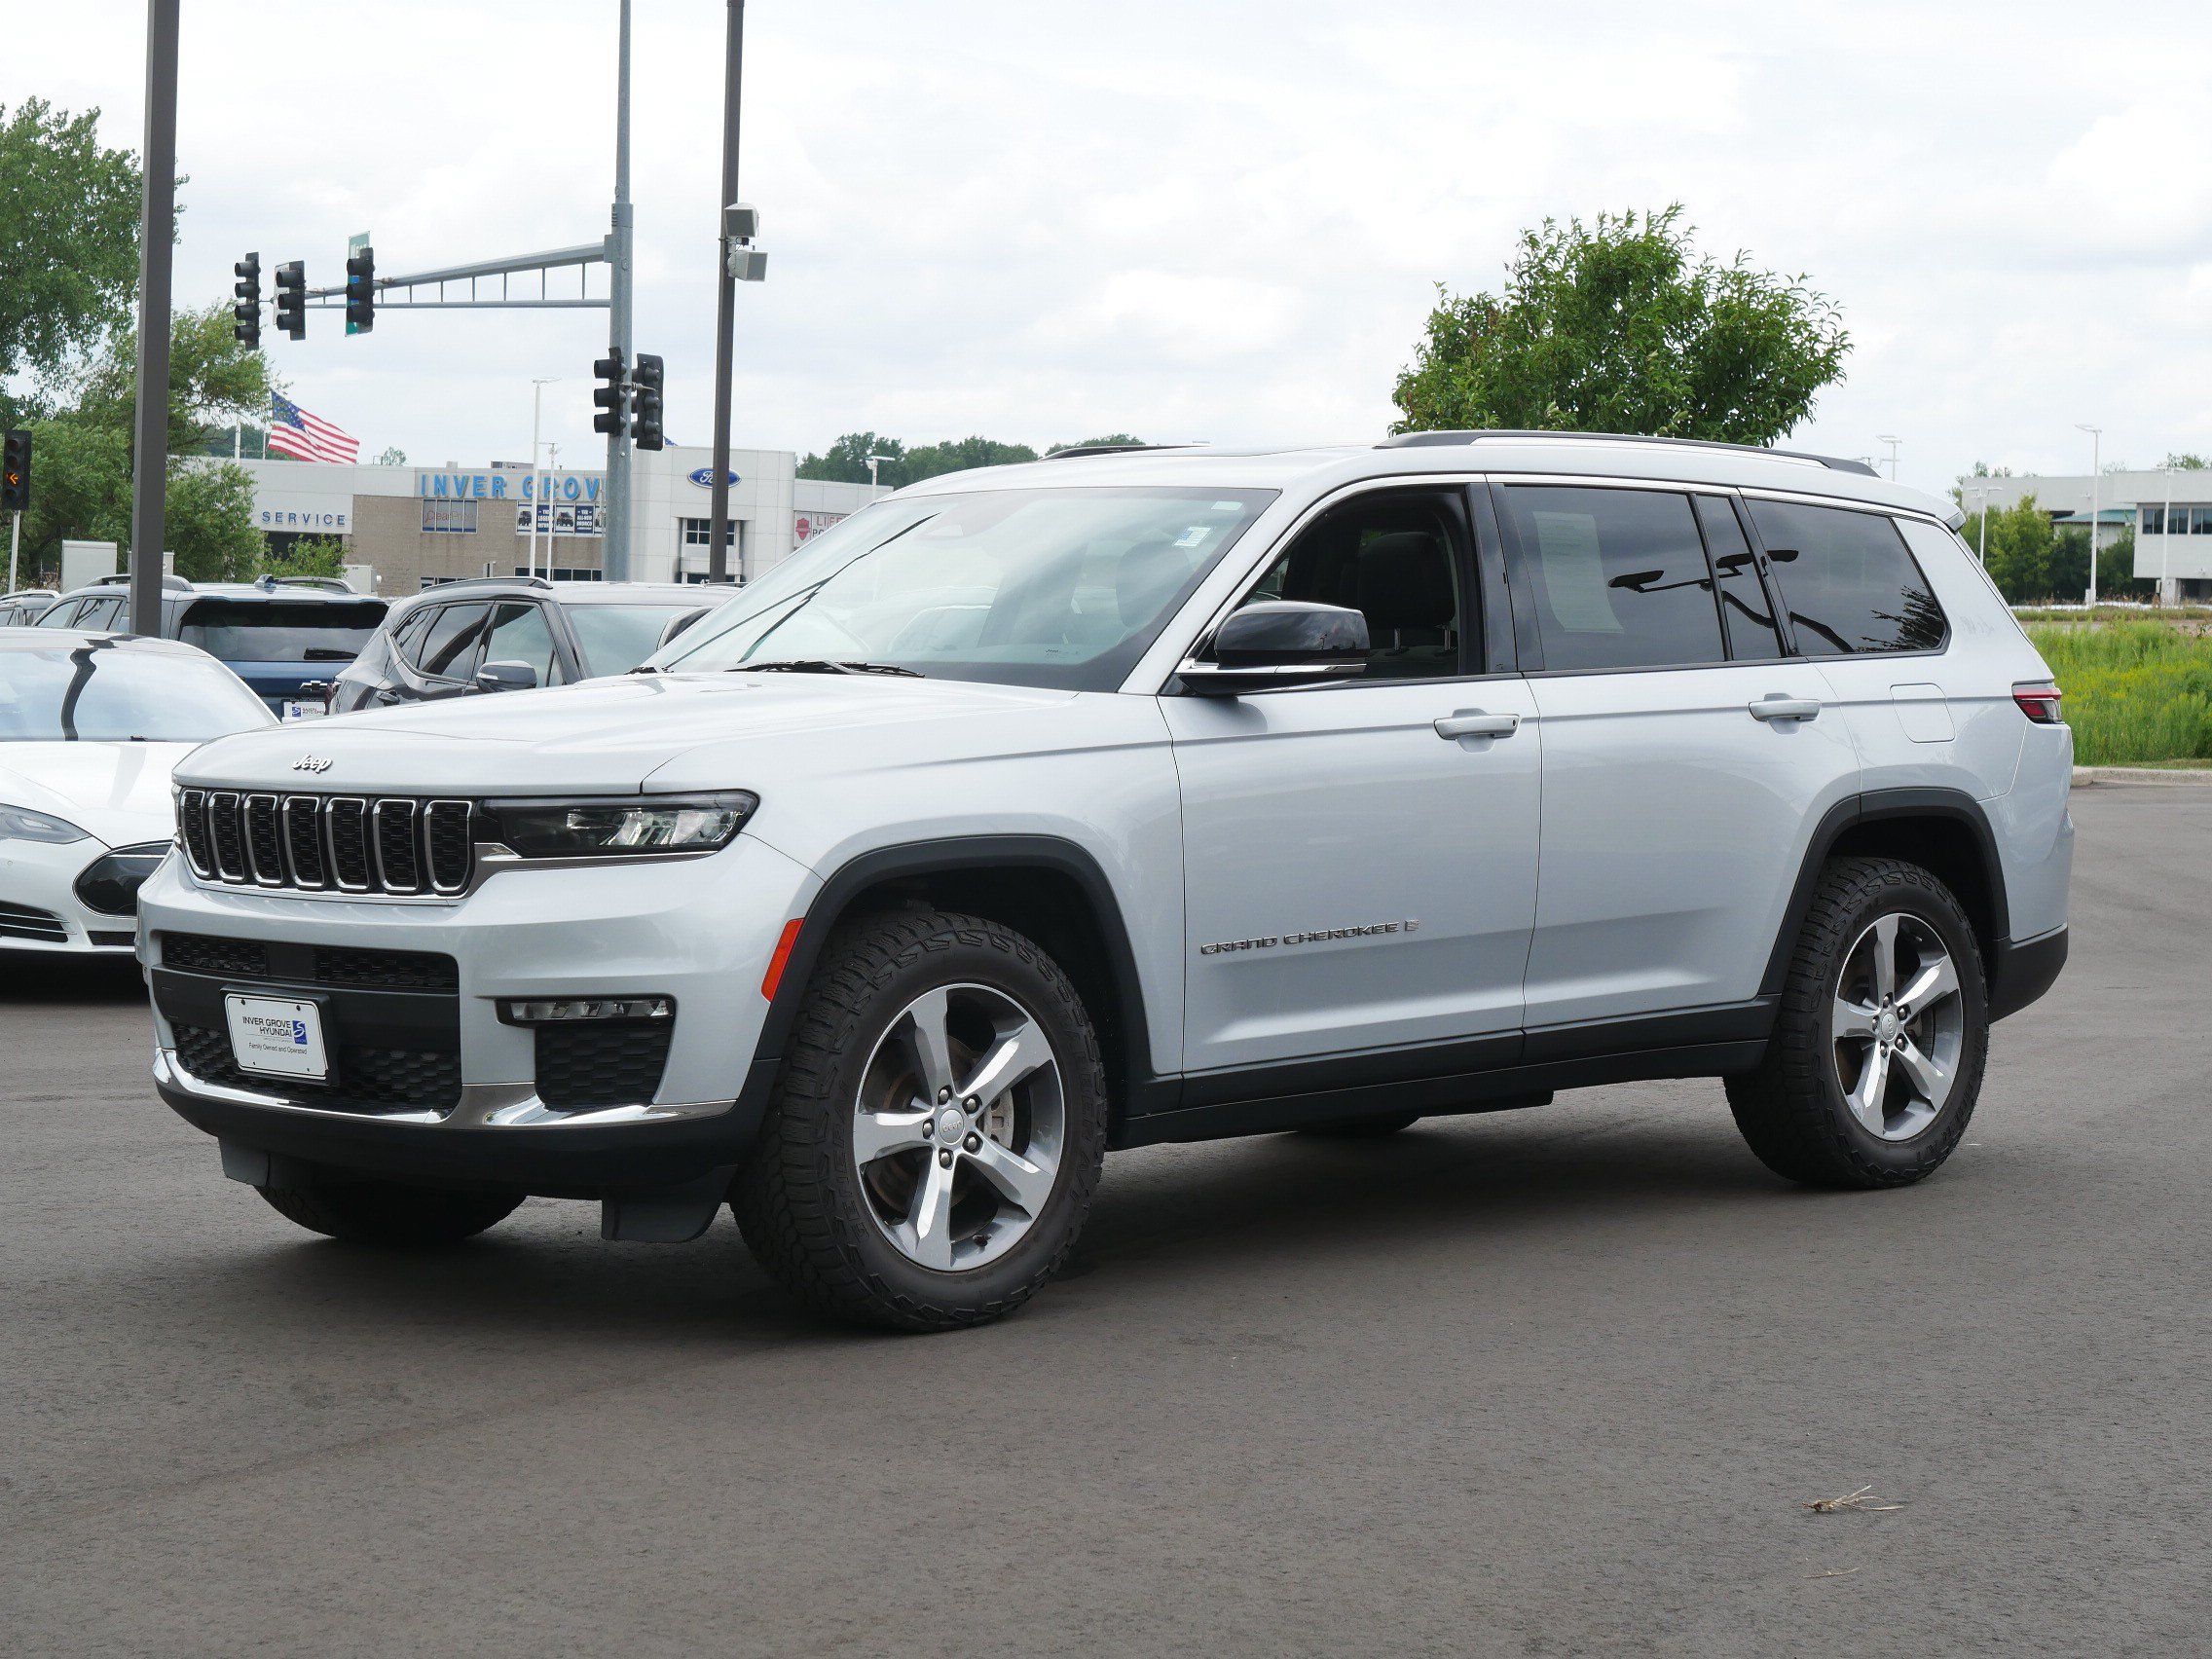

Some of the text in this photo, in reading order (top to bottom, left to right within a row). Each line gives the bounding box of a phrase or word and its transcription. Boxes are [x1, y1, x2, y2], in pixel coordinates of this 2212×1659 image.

[421, 473, 506, 498] INVER
[262, 511, 346, 526] SERVICE
[291, 753, 333, 774] Jeep
[1200, 937, 1277, 956] GRAND
[1283, 922, 1400, 946] CHEROKEE
[242, 1015, 291, 1029] INVER GROVE
[259, 1026, 293, 1038] HYUNDAI
[248, 1042, 263, 1051] Family
